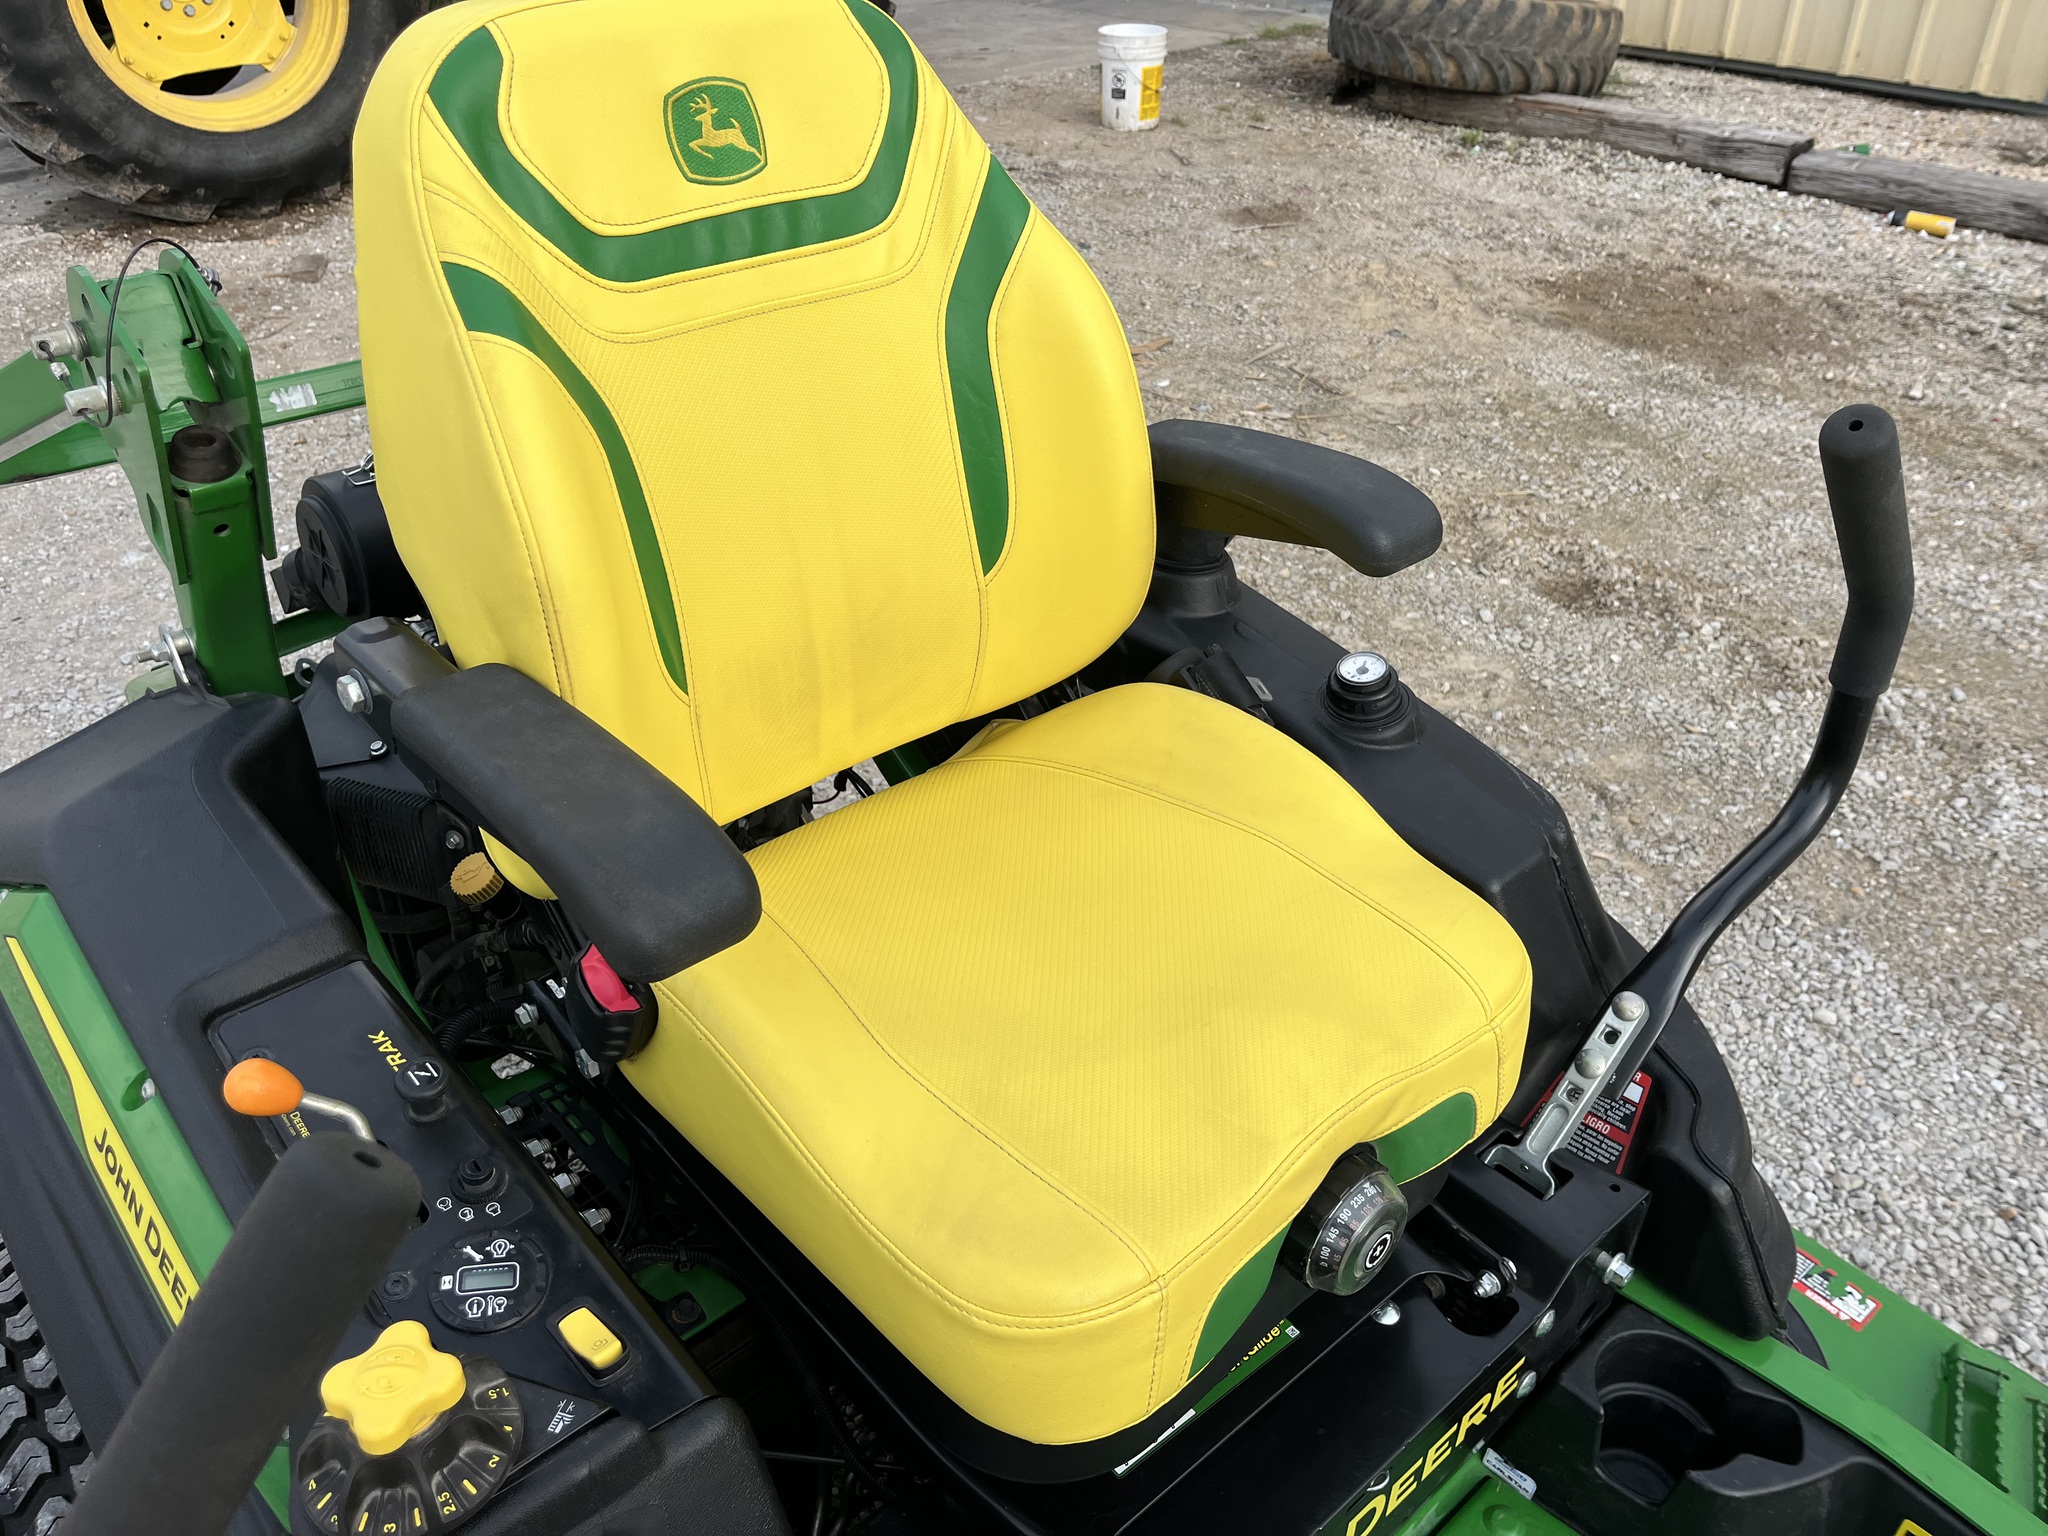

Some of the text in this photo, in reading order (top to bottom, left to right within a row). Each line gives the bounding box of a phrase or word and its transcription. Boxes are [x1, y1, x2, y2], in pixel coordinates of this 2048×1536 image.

[368, 1030, 407, 1072] RAK
[94, 1127, 191, 1311] JOHN DEE
[1326, 1227, 1340, 1243] 145
[1337, 1208, 1352, 1225] 190
[1350, 1193, 1366, 1209] 235
[488, 1386, 510, 1400] 1.5
[488, 1454, 500, 1468] 2
[1345, 1356, 1526, 1536] DEERE
[437, 1491, 457, 1515] 2.5
